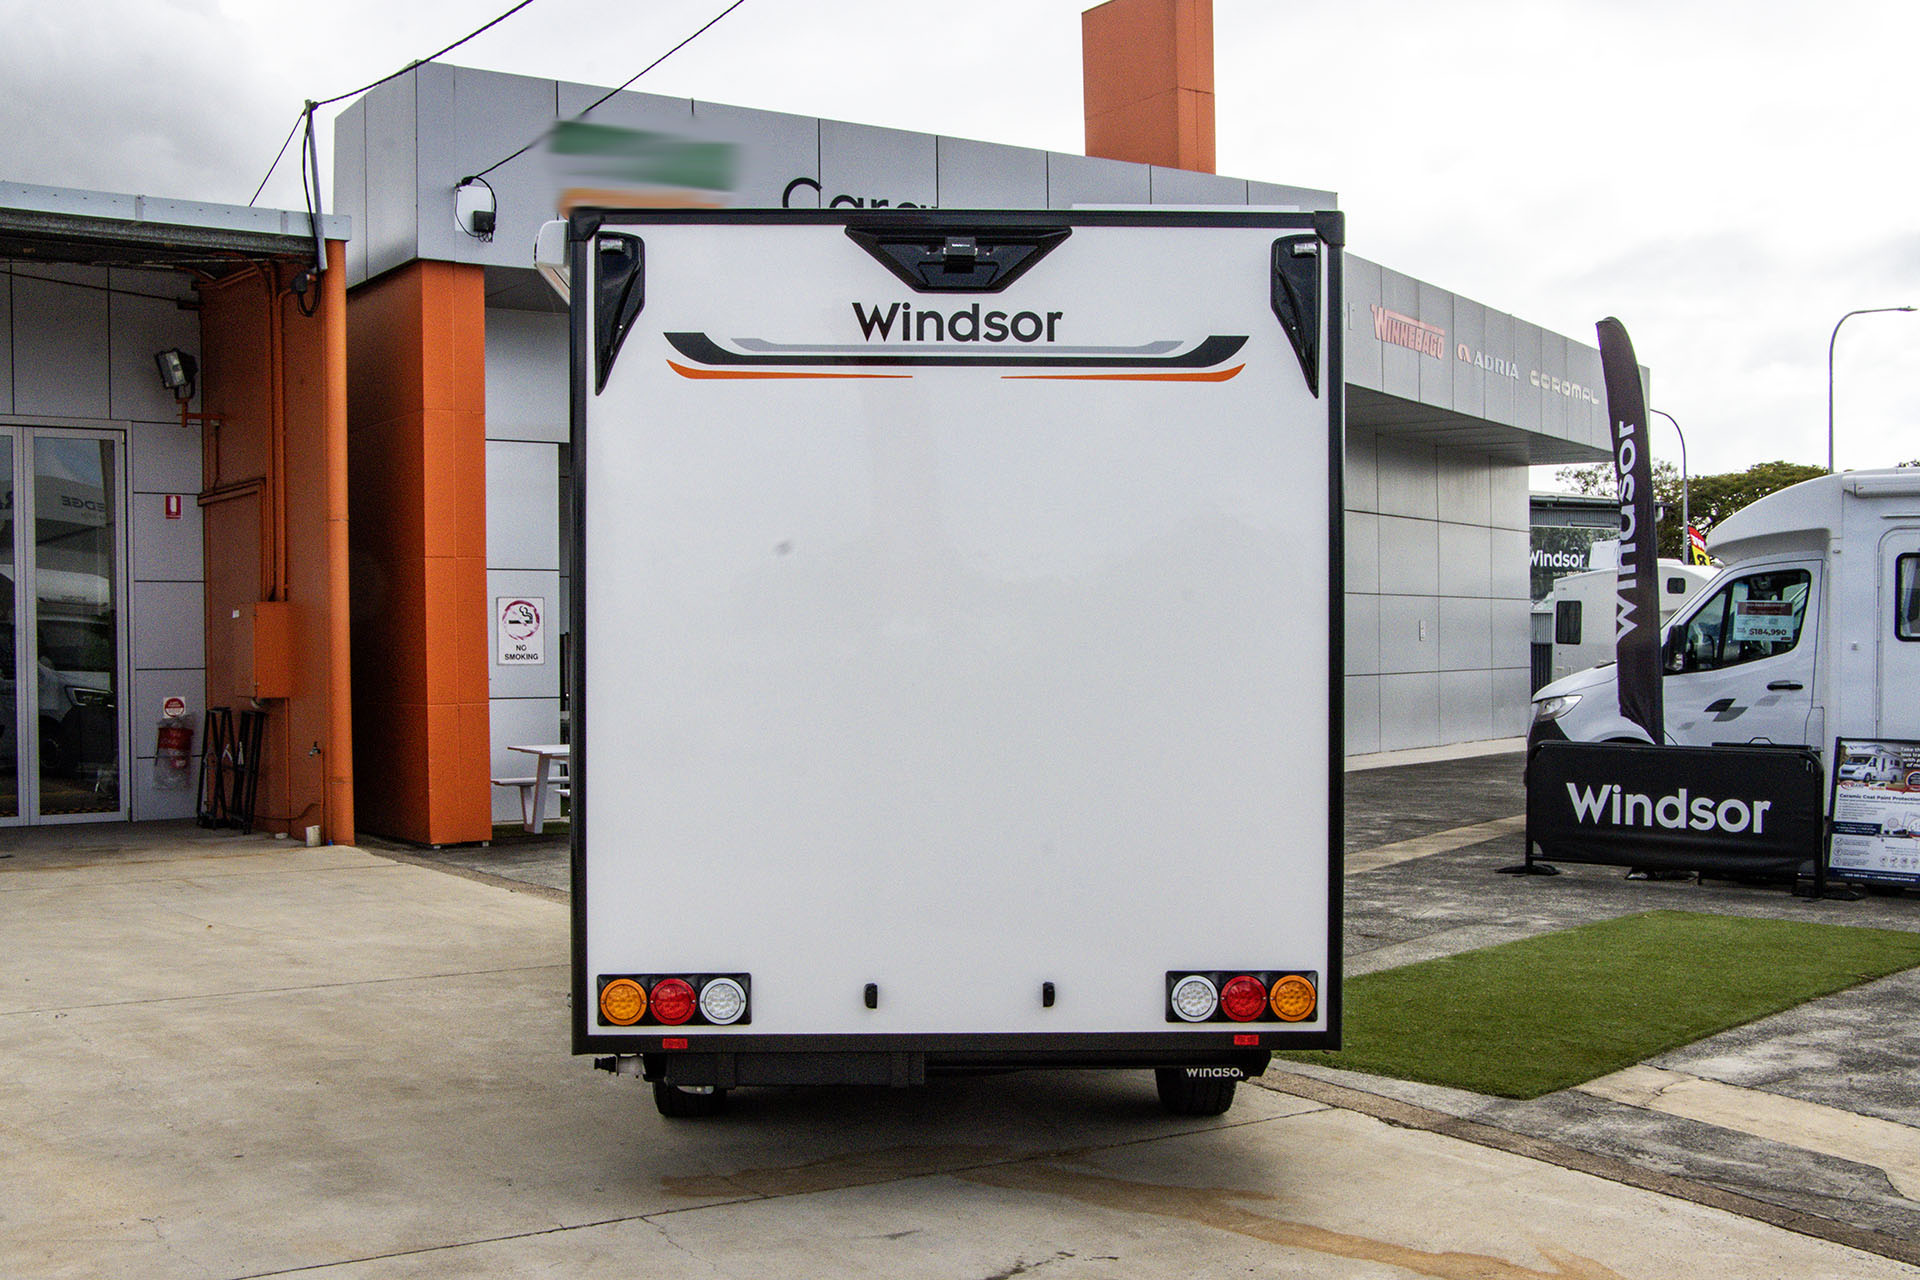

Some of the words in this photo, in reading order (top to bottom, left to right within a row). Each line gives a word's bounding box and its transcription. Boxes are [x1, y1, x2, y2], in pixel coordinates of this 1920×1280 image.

[852, 302, 1063, 342] Windsor
[1370, 304, 1445, 360] WINNEBAGO
[1473, 351, 1519, 380] ADRIA
[1616, 420, 1638, 645] Windsor
[1565, 782, 1771, 834] Windsor
